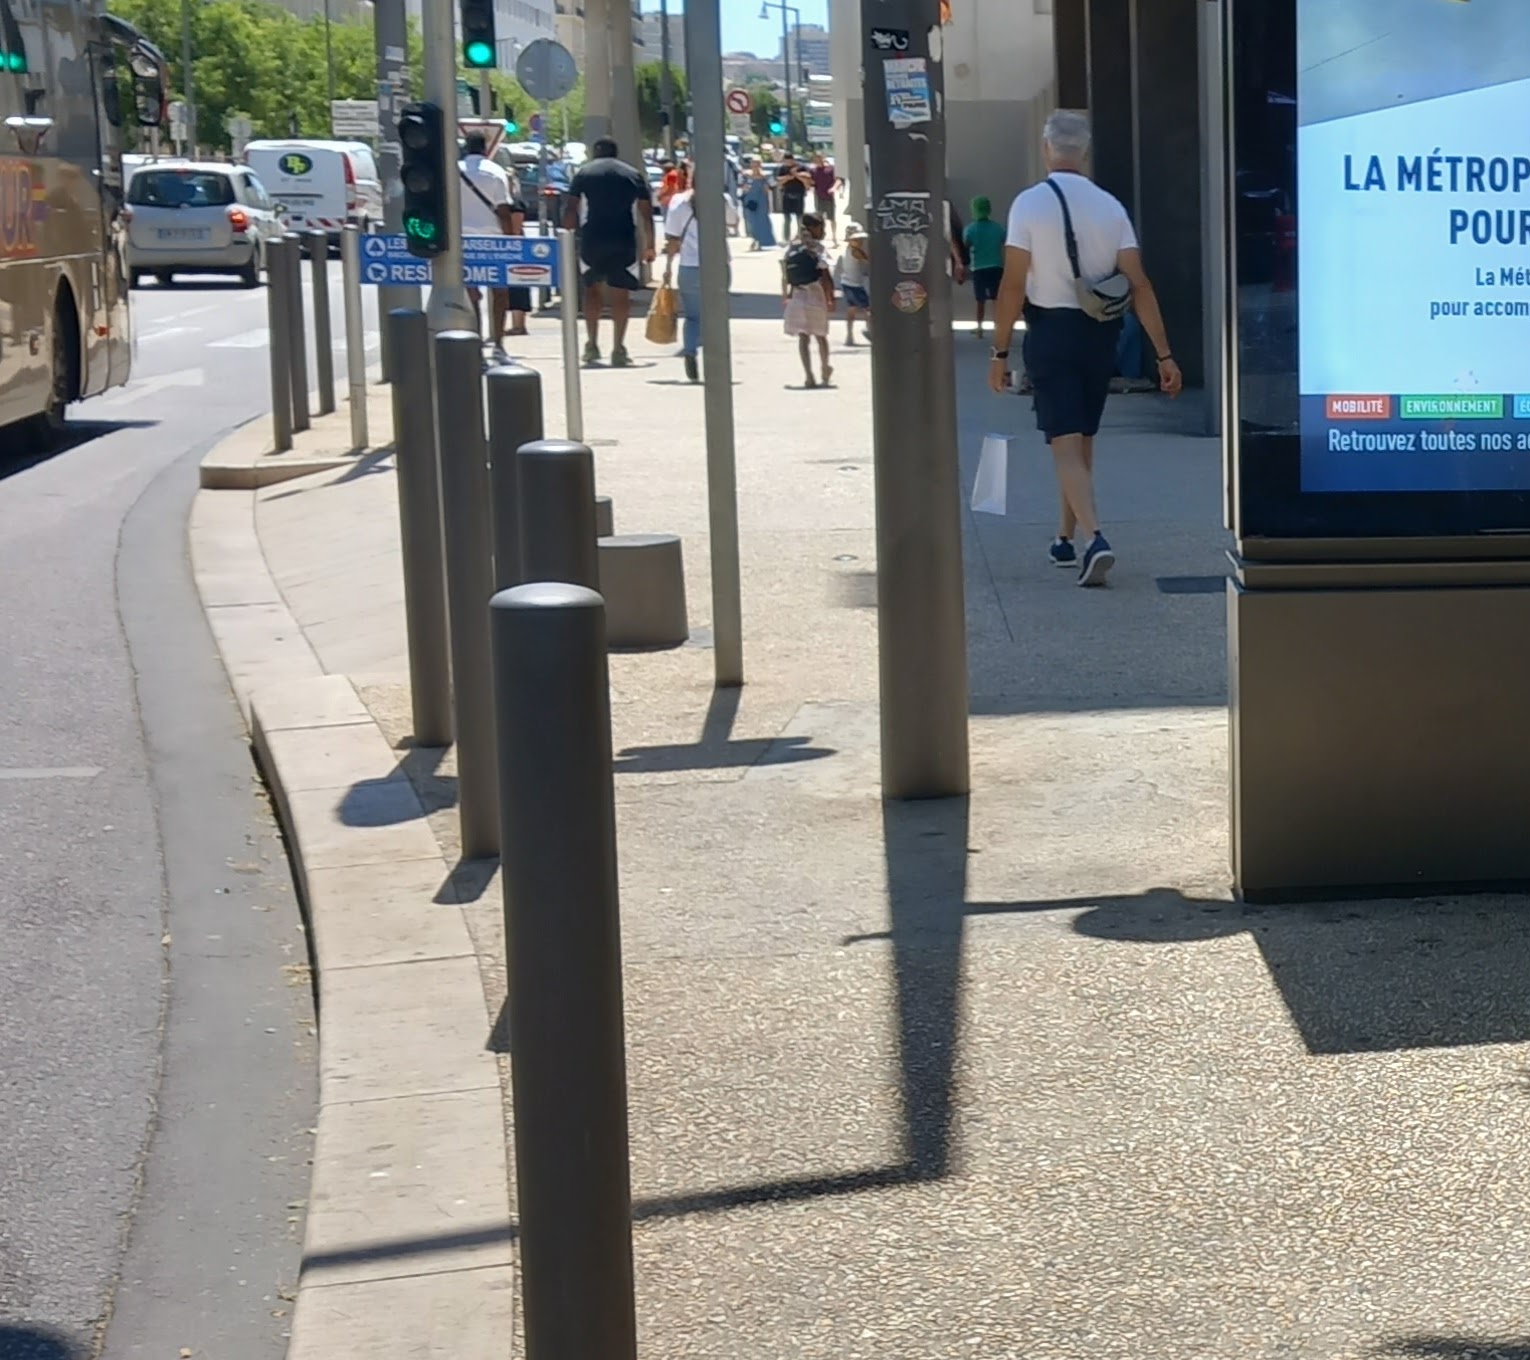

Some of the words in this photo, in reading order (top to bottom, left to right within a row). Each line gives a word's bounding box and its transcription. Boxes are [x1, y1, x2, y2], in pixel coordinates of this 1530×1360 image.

[1344, 154, 1387, 192] LA
[1475, 267, 1495, 286] La
[1430, 301, 1470, 320] pour
[1332, 397, 1383, 414] MOBILITÉ
[1406, 399, 1497, 414] ENVIRONNEMENT
[1328, 428, 1417, 452] Retrouvez
[1420, 429, 1476, 451] toutes
[1480, 433, 1513, 451] nos
